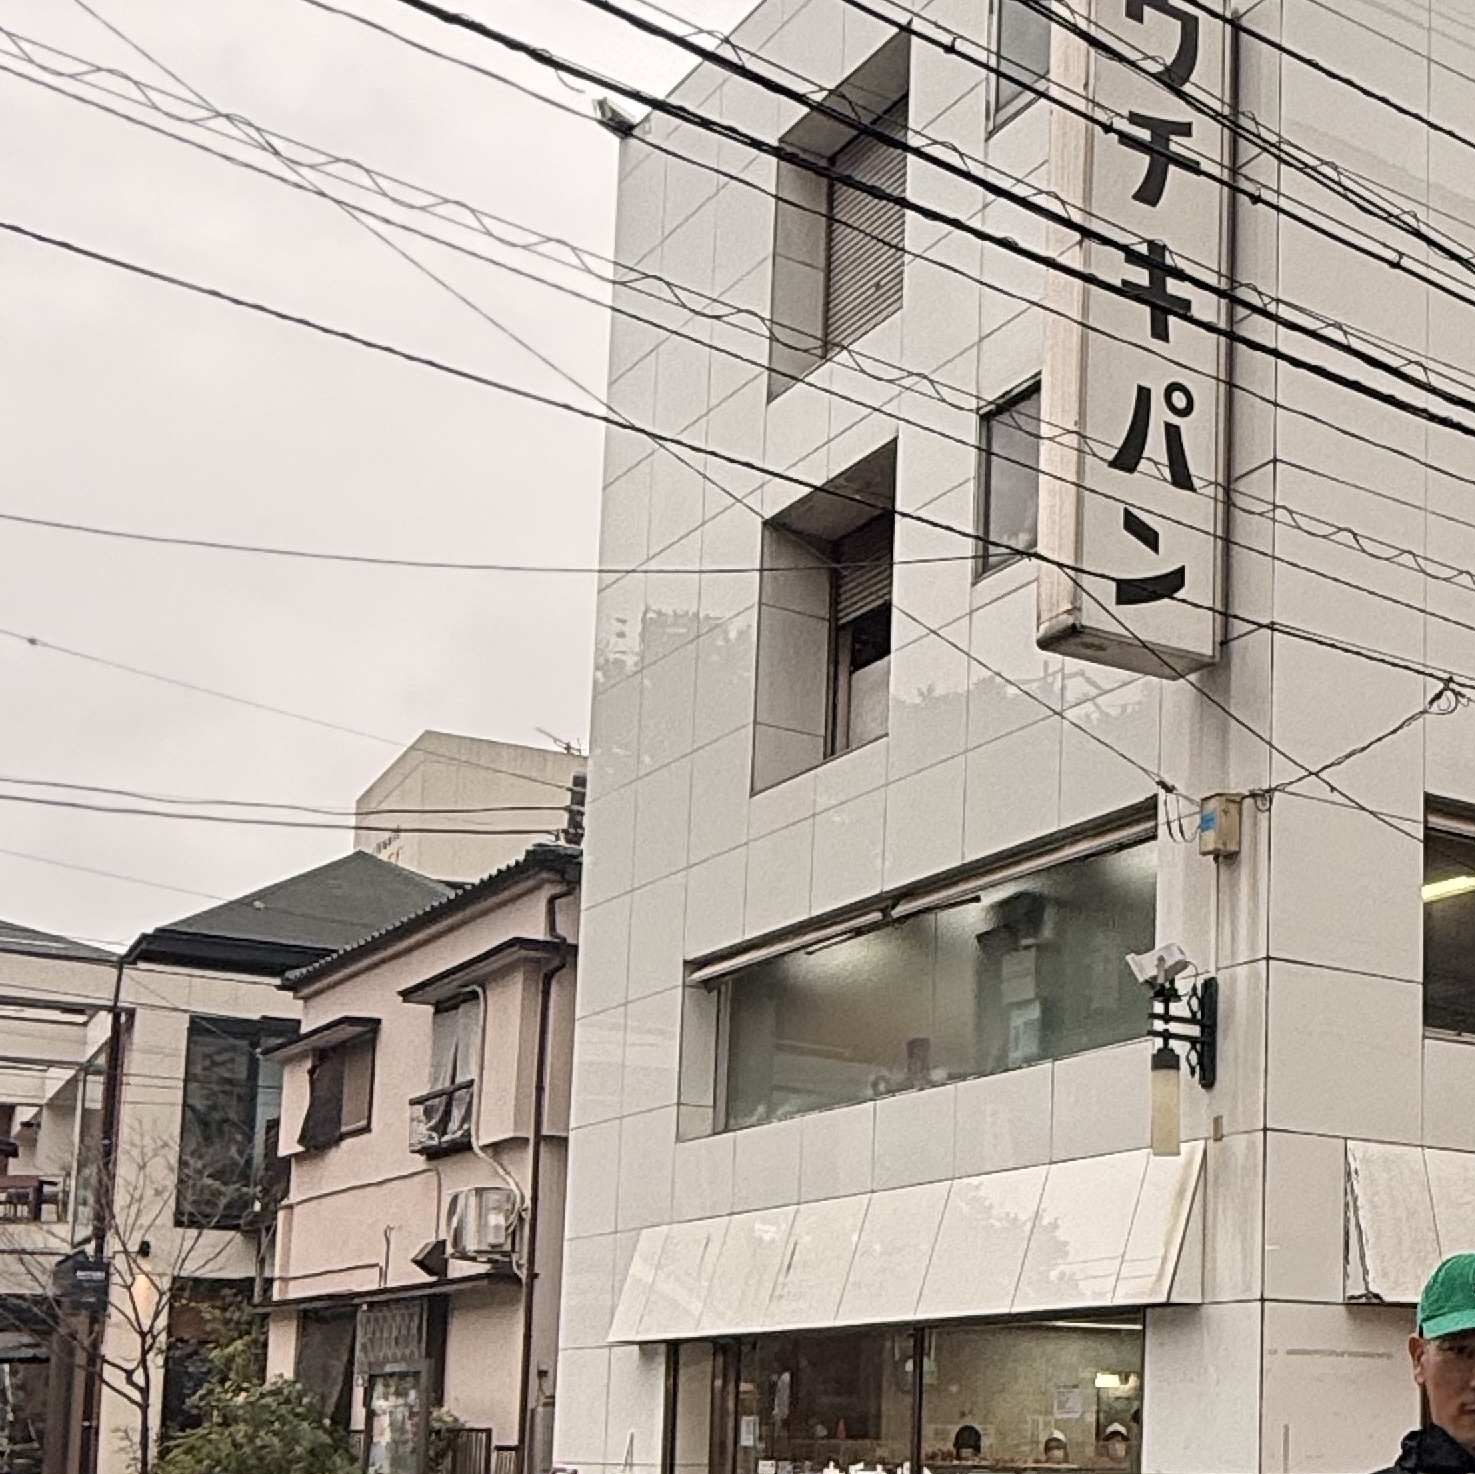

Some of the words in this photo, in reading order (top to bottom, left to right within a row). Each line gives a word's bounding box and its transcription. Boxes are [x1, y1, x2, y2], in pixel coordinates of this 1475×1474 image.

[1107, 0, 1201, 607] ウチキパン
